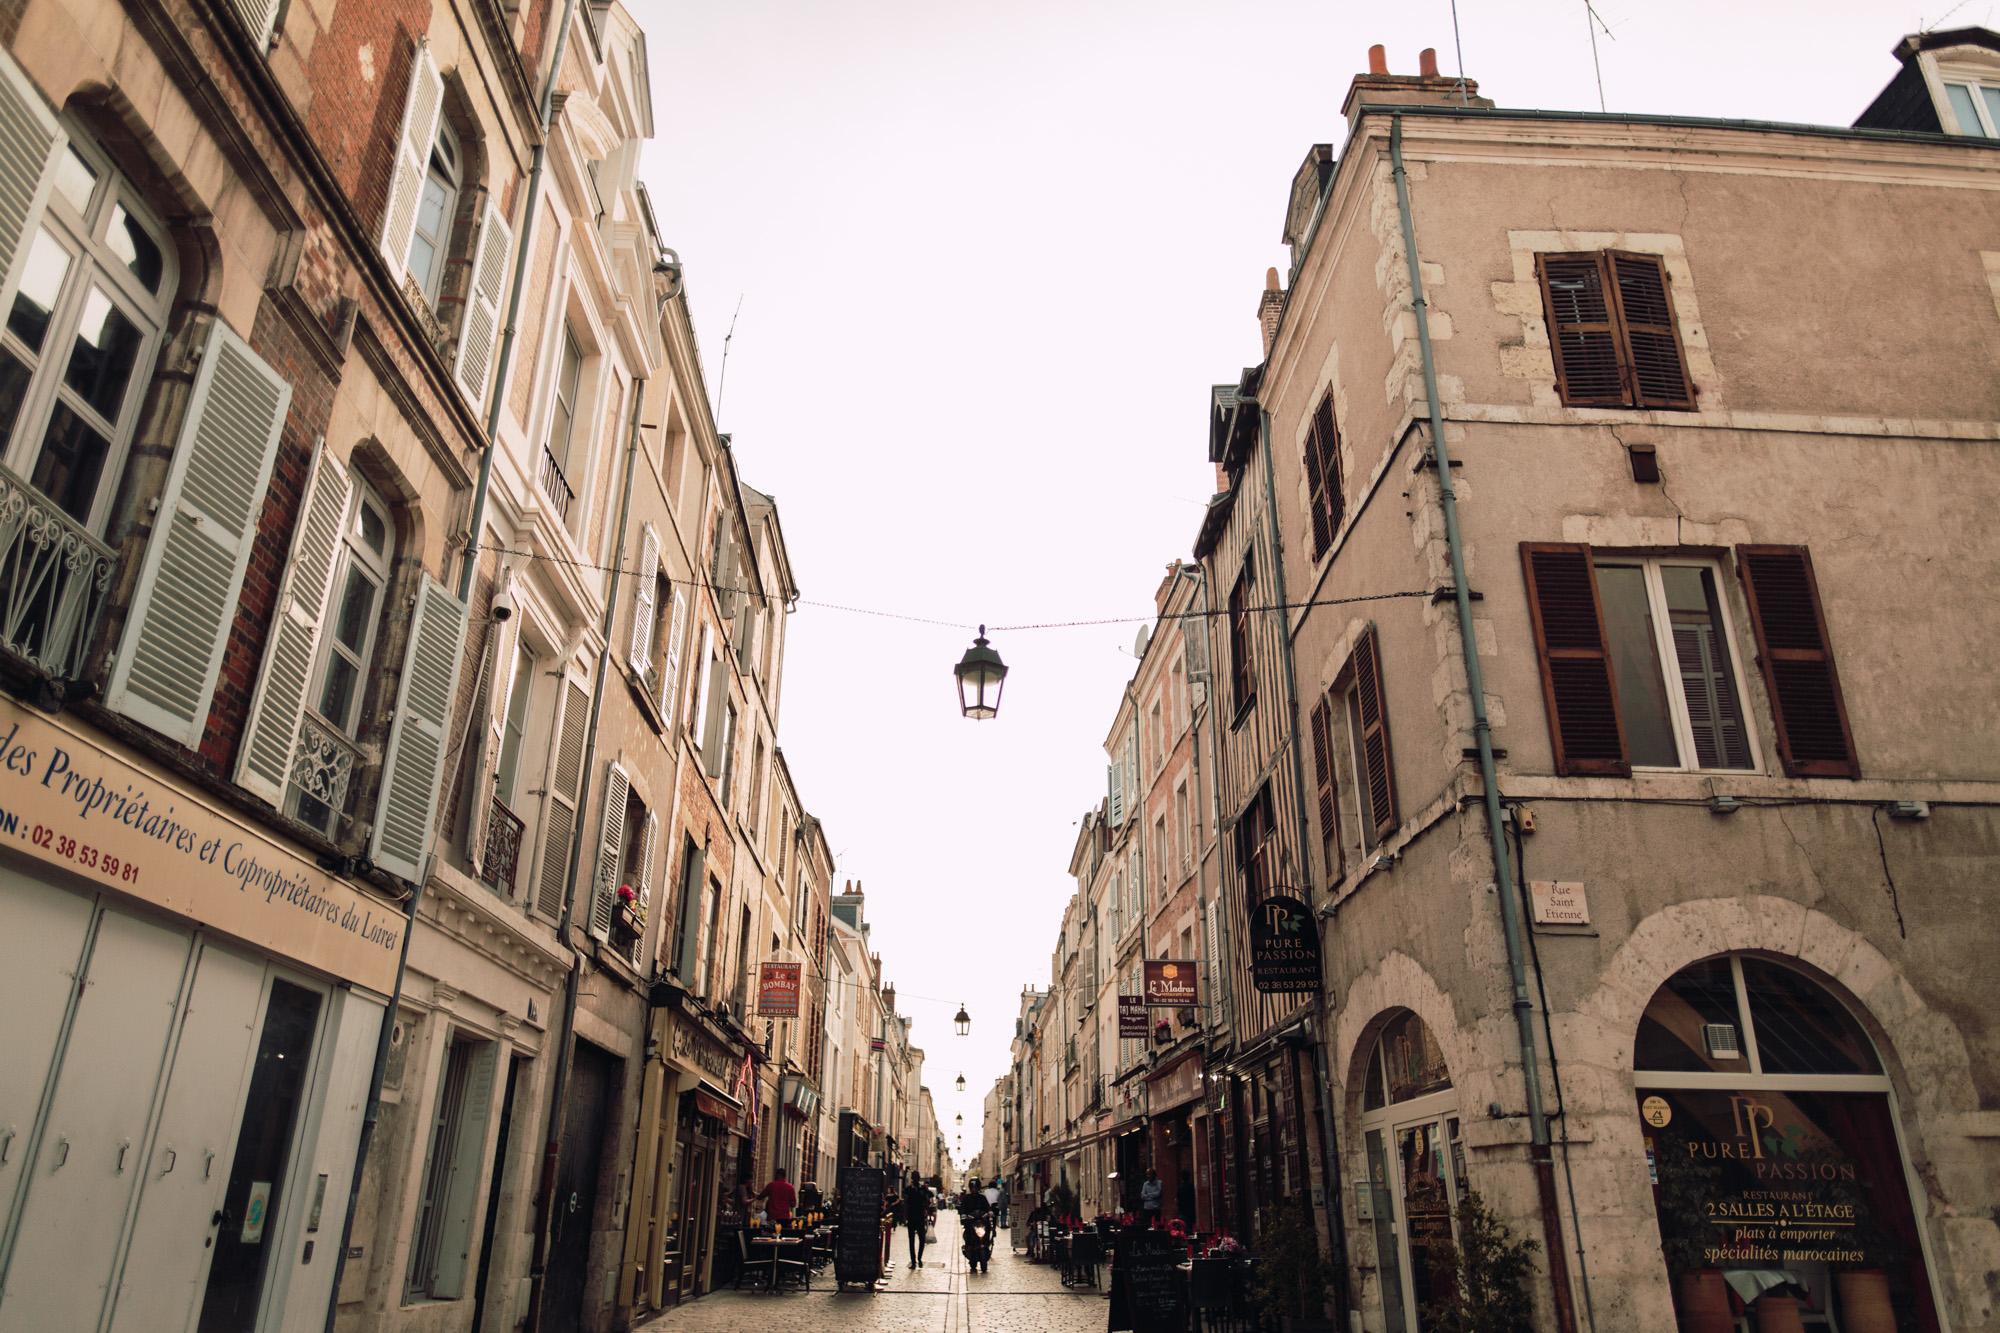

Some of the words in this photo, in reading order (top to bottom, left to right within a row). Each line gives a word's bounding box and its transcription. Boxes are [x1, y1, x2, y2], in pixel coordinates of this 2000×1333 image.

[0, 722, 37, 776] des
[41, 747, 197, 854] Propriétaires
[199, 838, 222, 865] et
[223, 842, 340, 925] Copropriétaires
[341, 901, 360, 934] du
[361, 911, 398, 951] Loiret
[32, 825, 53, 849] 02
[56, 835, 77, 859] 38
[79, 845, 99, 868] 53
[101, 854, 120, 876] 59
[122, 863, 139, 884] 81
[1552, 885, 1571, 894] Rue
[1550, 896, 1574, 907] Saint
[1545, 909, 1583, 919] Etienne
[1265, 938, 1302, 949] PURE
[1257, 949, 1316, 960] PASSION
[775, 971, 786, 979] Le
[1257, 966, 1317, 975] RESTAURANT
[762, 981, 798, 990] BOMBAY
[1147, 980, 1162, 996] Le
[1161, 980, 1195, 993] Madras
[1307, 980, 1319, 988] 92
[1688, 1142, 1750, 1159] PURE
[1756, 1163, 1856, 1180] PASSION
[1743, 1191, 1814, 1201] RESTAURANT
[1708, 1203, 1716, 1216] 2
[1720, 1203, 1775, 1217] SALLES
[1780, 1205, 1789, 1217] A
[1793, 1202, 1855, 1218] L'ÉTAGE
[1735, 1226, 1765, 1241] plats
[1769, 1227, 1776, 1239] à
[1780, 1229, 1835, 1242] emporter
[1704, 1244, 1778, 1263] spécialités
[1783, 1249, 1864, 1262] marocaines
